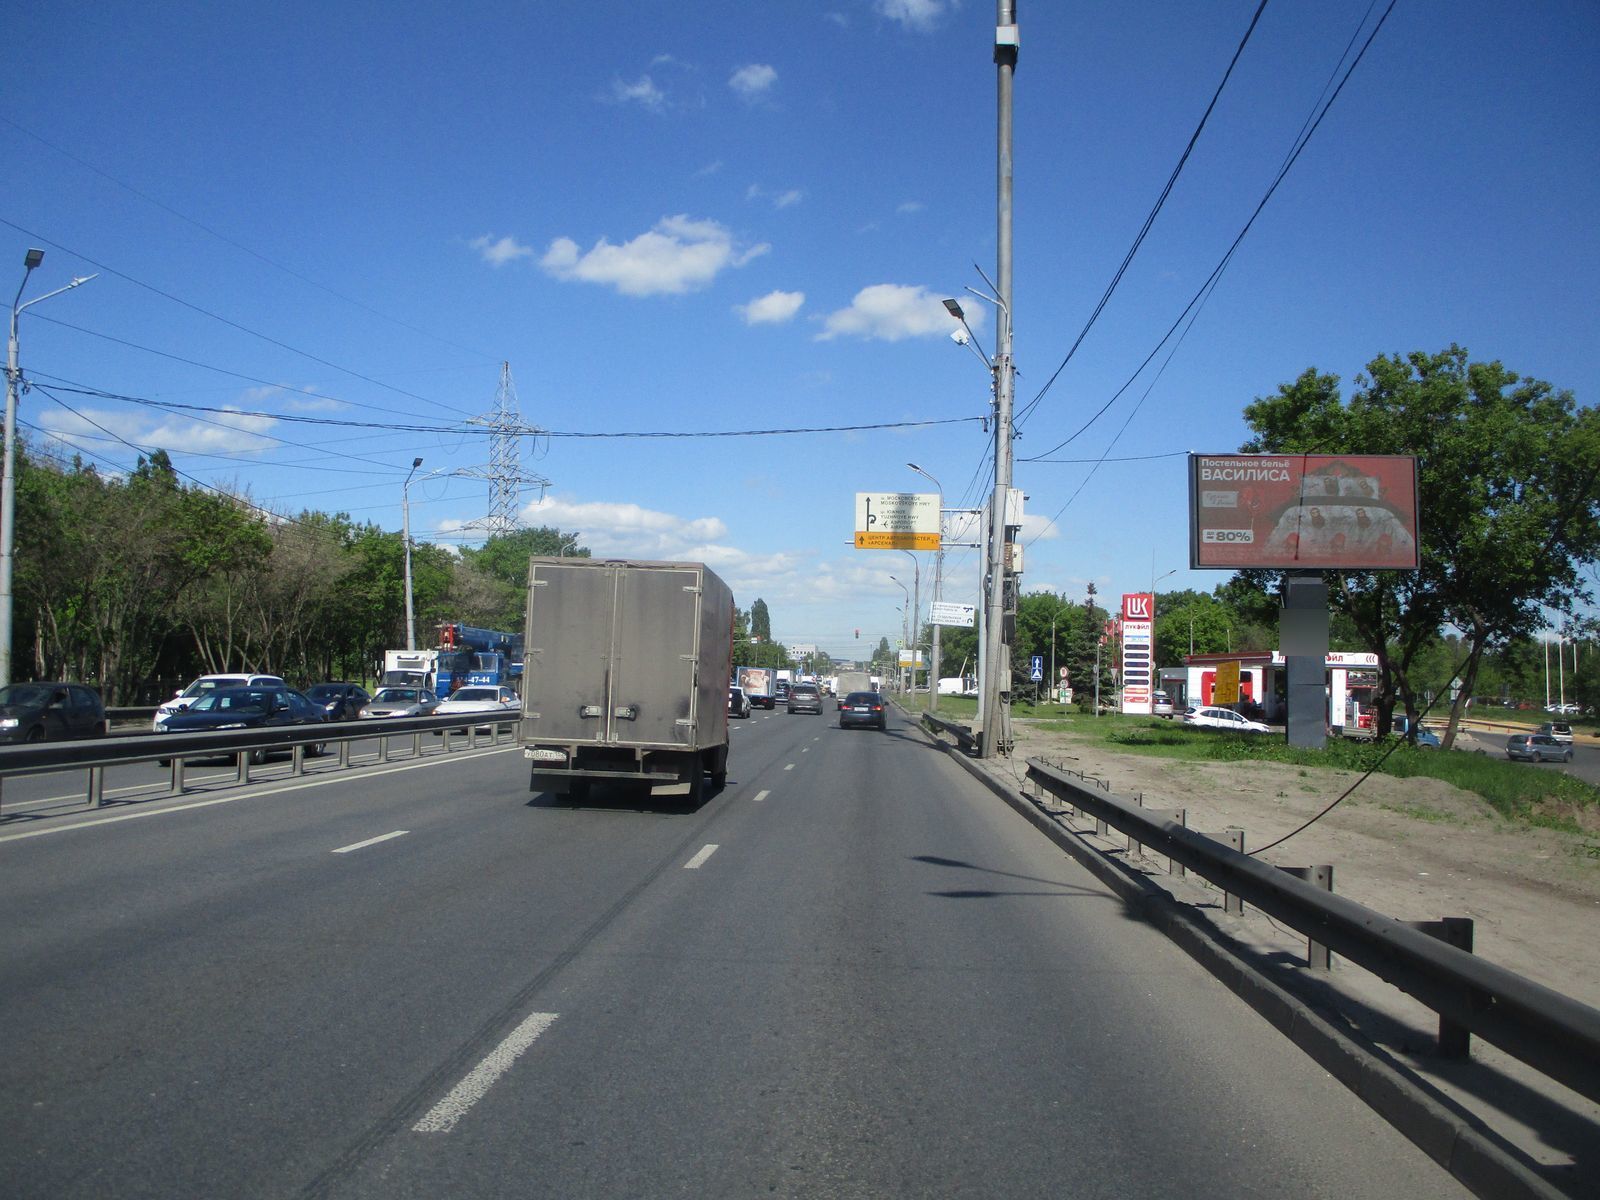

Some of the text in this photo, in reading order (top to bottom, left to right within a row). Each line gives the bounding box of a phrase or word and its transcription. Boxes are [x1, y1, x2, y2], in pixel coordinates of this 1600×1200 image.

[1201, 458, 1290, 468] Постельное бельё
[1202, 469, 1290, 481] ВАСИЛИСА
